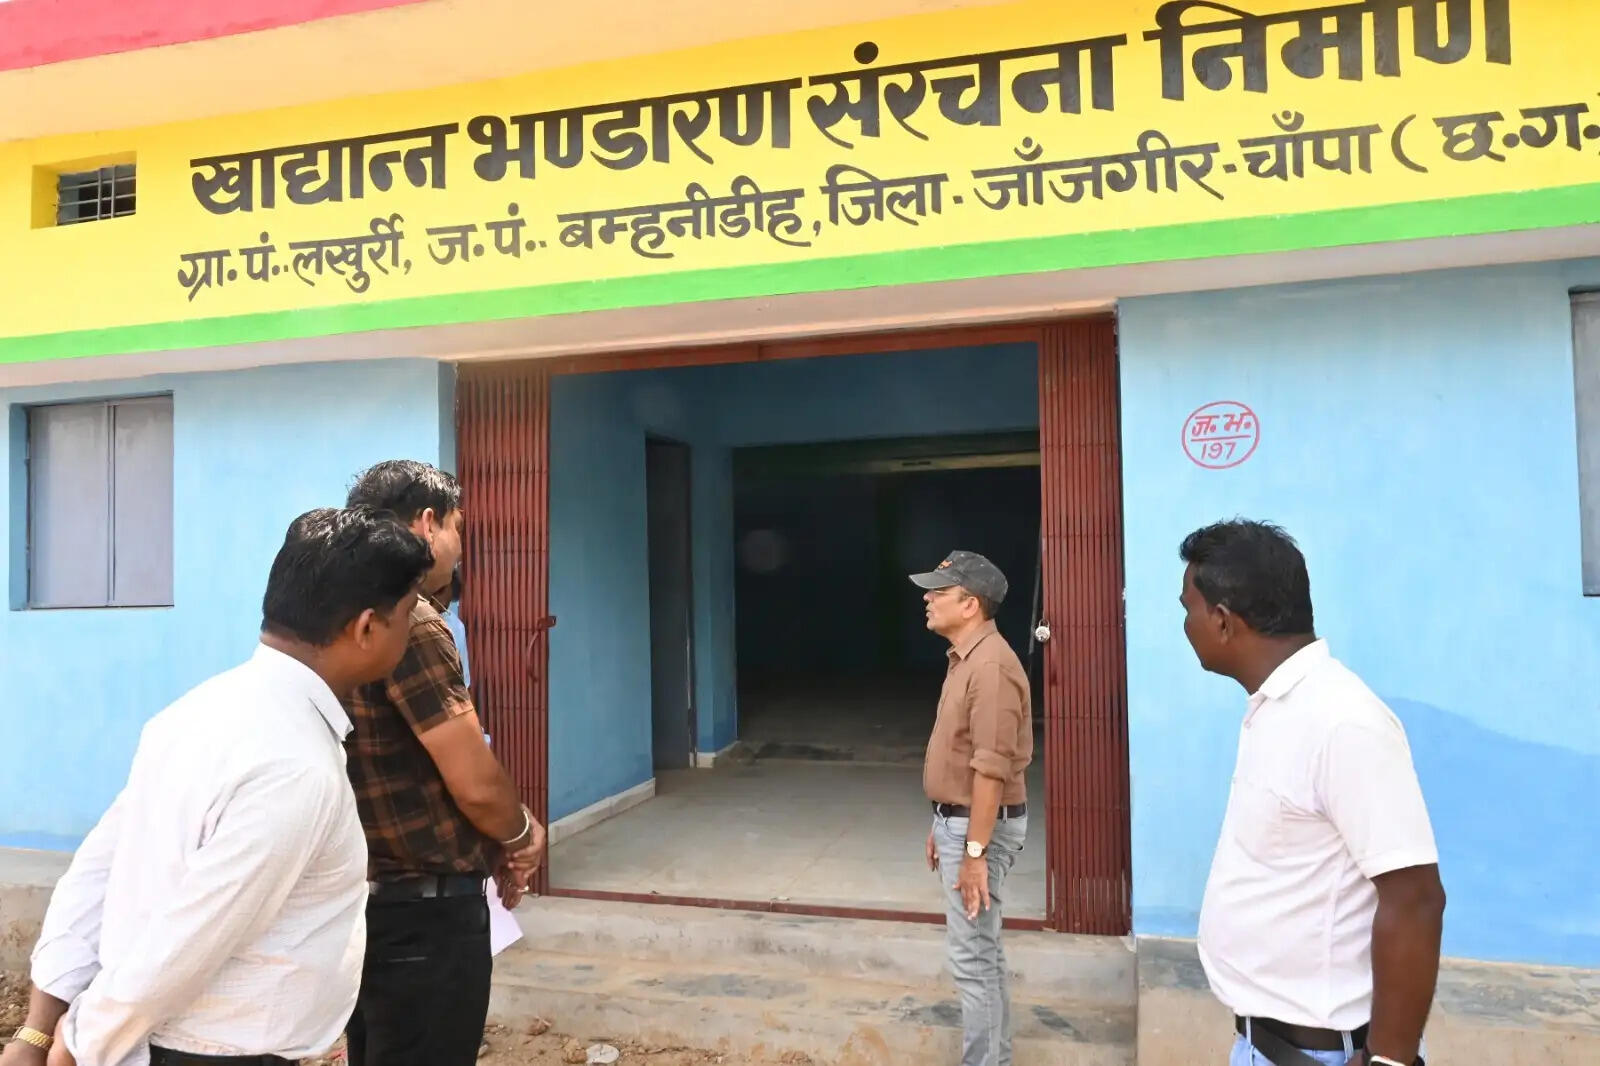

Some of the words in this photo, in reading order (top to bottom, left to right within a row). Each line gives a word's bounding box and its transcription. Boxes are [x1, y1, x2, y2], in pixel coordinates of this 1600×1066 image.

[189, 123, 460, 215] खाद्यान्न
[466, 77, 803, 183] भण्डारण
[806, 33, 1128, 151] संरचना
[1201, 441, 1237, 460] 197
